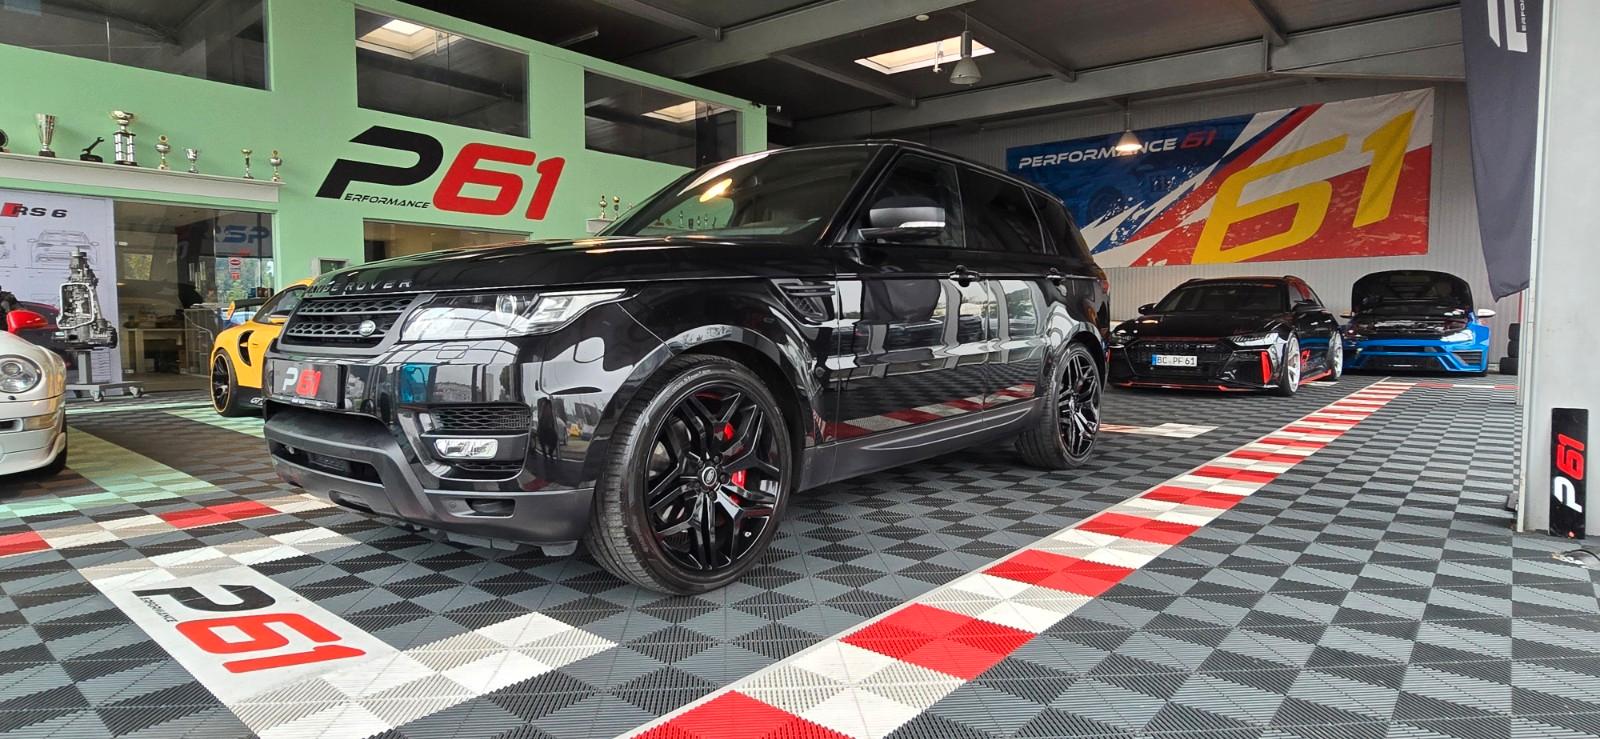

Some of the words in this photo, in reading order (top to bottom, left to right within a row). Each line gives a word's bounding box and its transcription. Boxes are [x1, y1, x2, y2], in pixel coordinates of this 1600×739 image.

[1018, 137, 1178, 169] PERFORMNCE
[1179, 131, 1216, 149] 61
[315, 125, 565, 220] P61
[1191, 109, 1417, 265] 61
[12, 205, 47, 216] RS
[51, 209, 68, 218] 6
[344, 193, 430, 209] ERFORMANCE
[344, 279, 411, 291] ROVER
[1157, 356, 1168, 364] BC
[1172, 356, 1183, 365] PF
[1184, 357, 1195, 366] 61
[282, 367, 321, 397] P61
[1554, 433, 1585, 513] P61
[132, 584, 367, 674] P61
